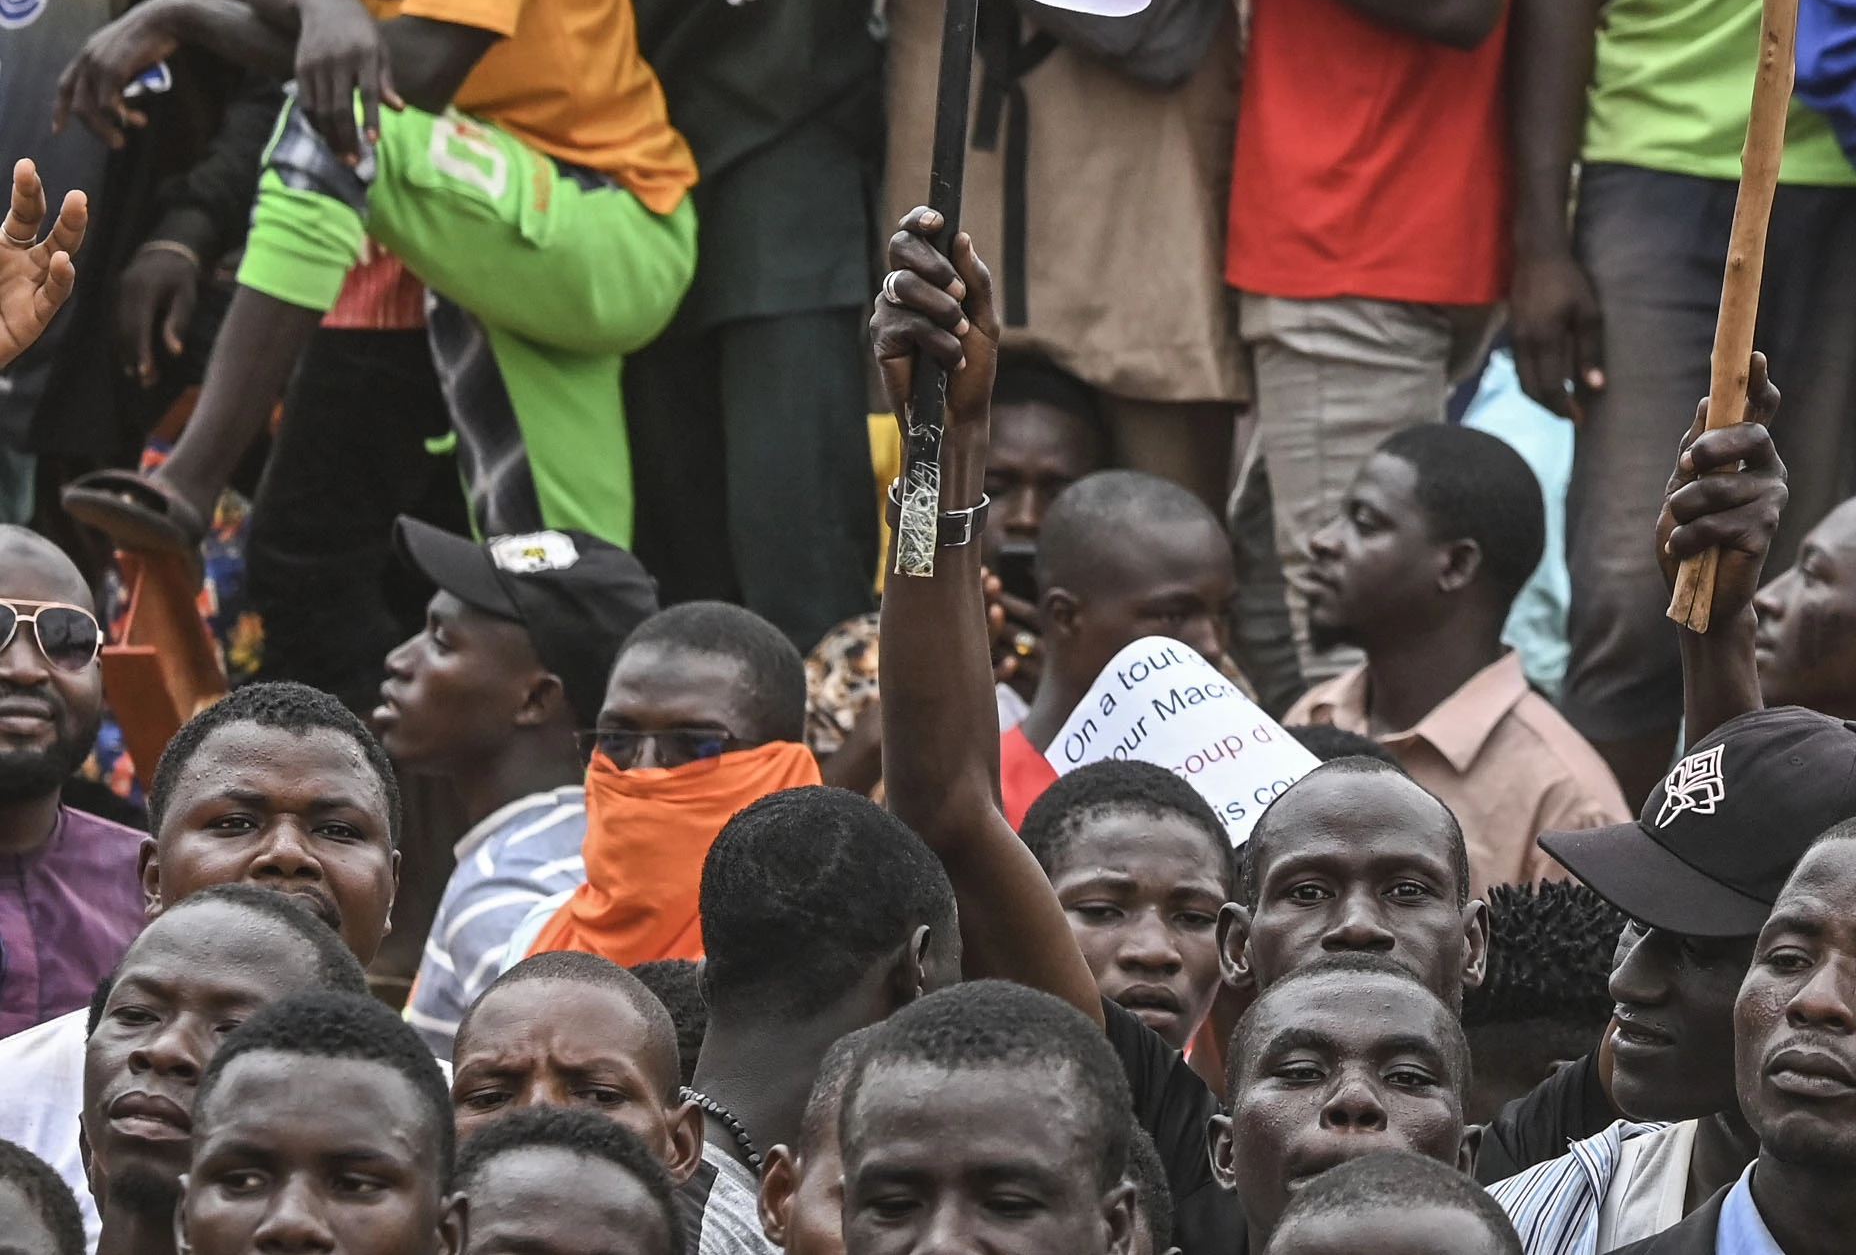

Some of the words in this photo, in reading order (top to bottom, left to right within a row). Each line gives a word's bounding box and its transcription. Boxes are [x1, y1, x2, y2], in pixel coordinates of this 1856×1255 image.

[1064, 718, 1098, 764] On
[1099, 692, 1118, 717] a
[1117, 646, 1185, 691] tout
[1112, 715, 1148, 762] our
[1253, 776, 1296, 806] co
